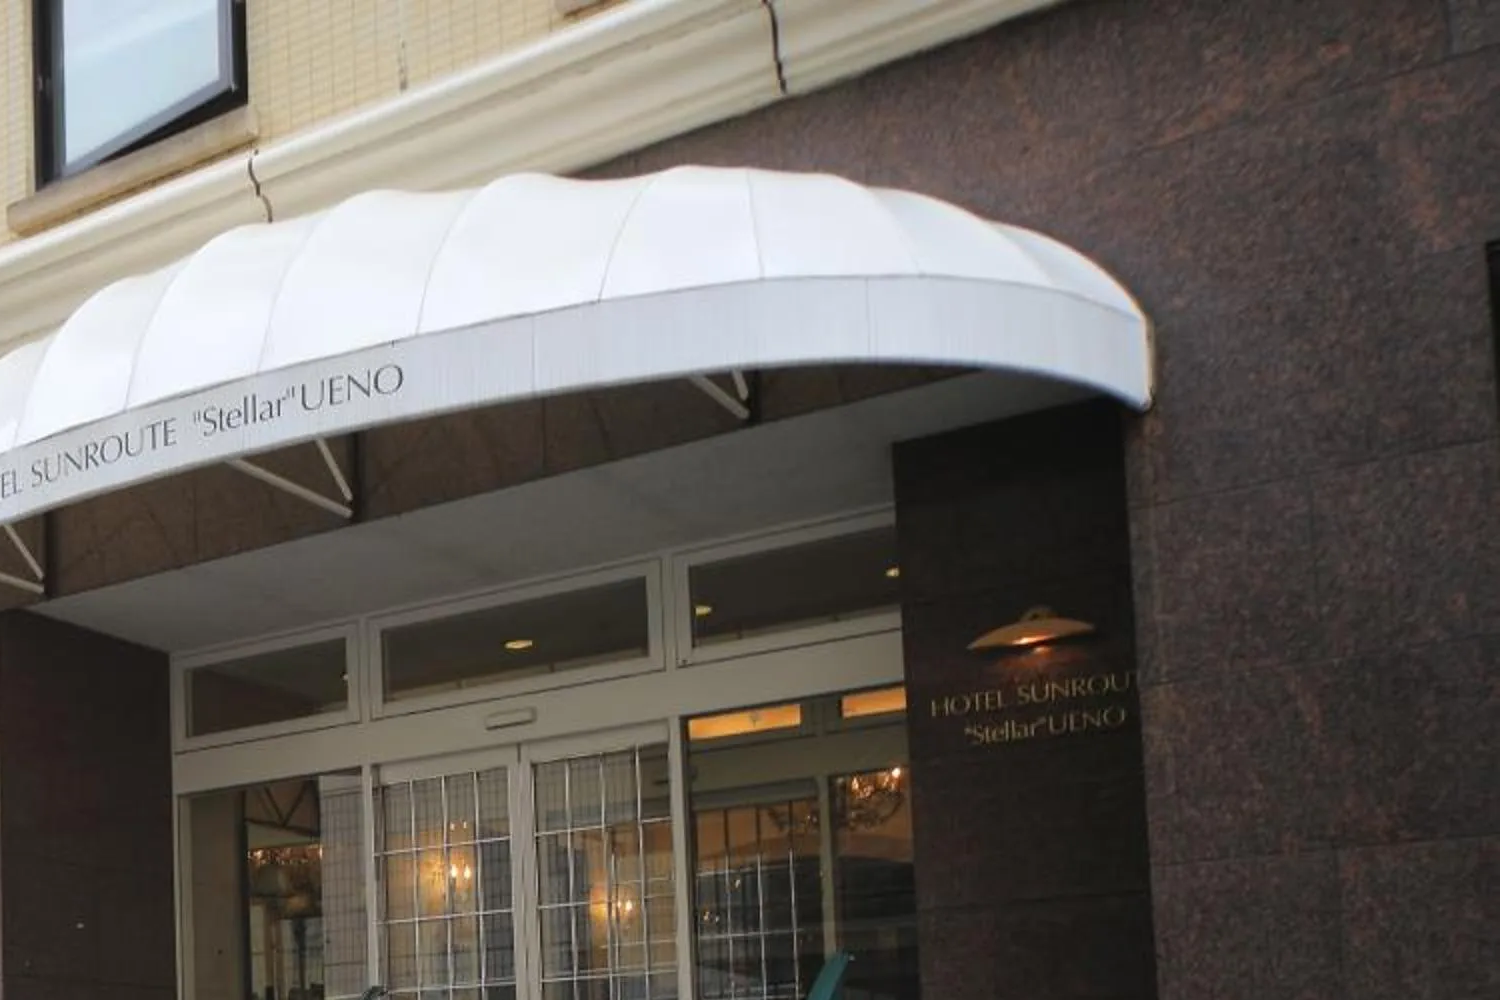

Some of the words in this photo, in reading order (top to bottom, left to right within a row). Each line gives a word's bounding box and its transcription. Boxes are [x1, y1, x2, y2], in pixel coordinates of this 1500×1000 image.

[31, 419, 177, 488] SUNROUTE
[301, 363, 404, 411] UENO
[930, 689, 1007, 717] HOTEL
[1017, 671, 1138, 705] SUNROU
[1049, 706, 1127, 734] UENO
